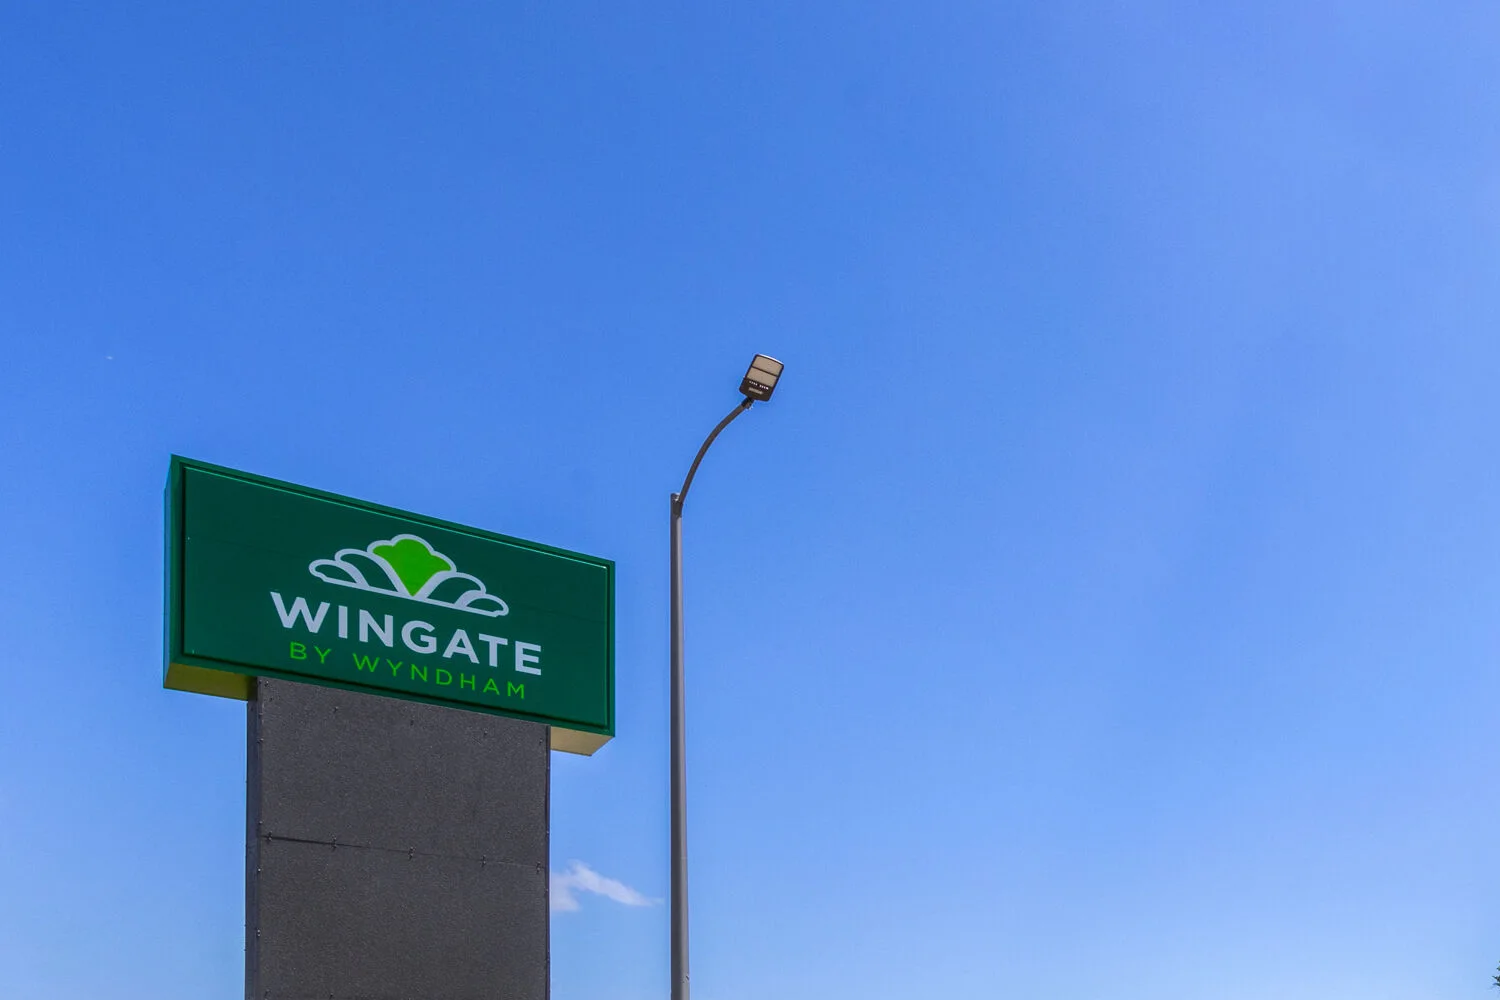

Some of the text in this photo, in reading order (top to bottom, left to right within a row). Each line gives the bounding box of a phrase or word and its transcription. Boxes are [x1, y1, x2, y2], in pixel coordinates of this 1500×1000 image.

[270, 592, 542, 676] WINGATE
[289, 641, 525, 700] BY WYNDHAM
